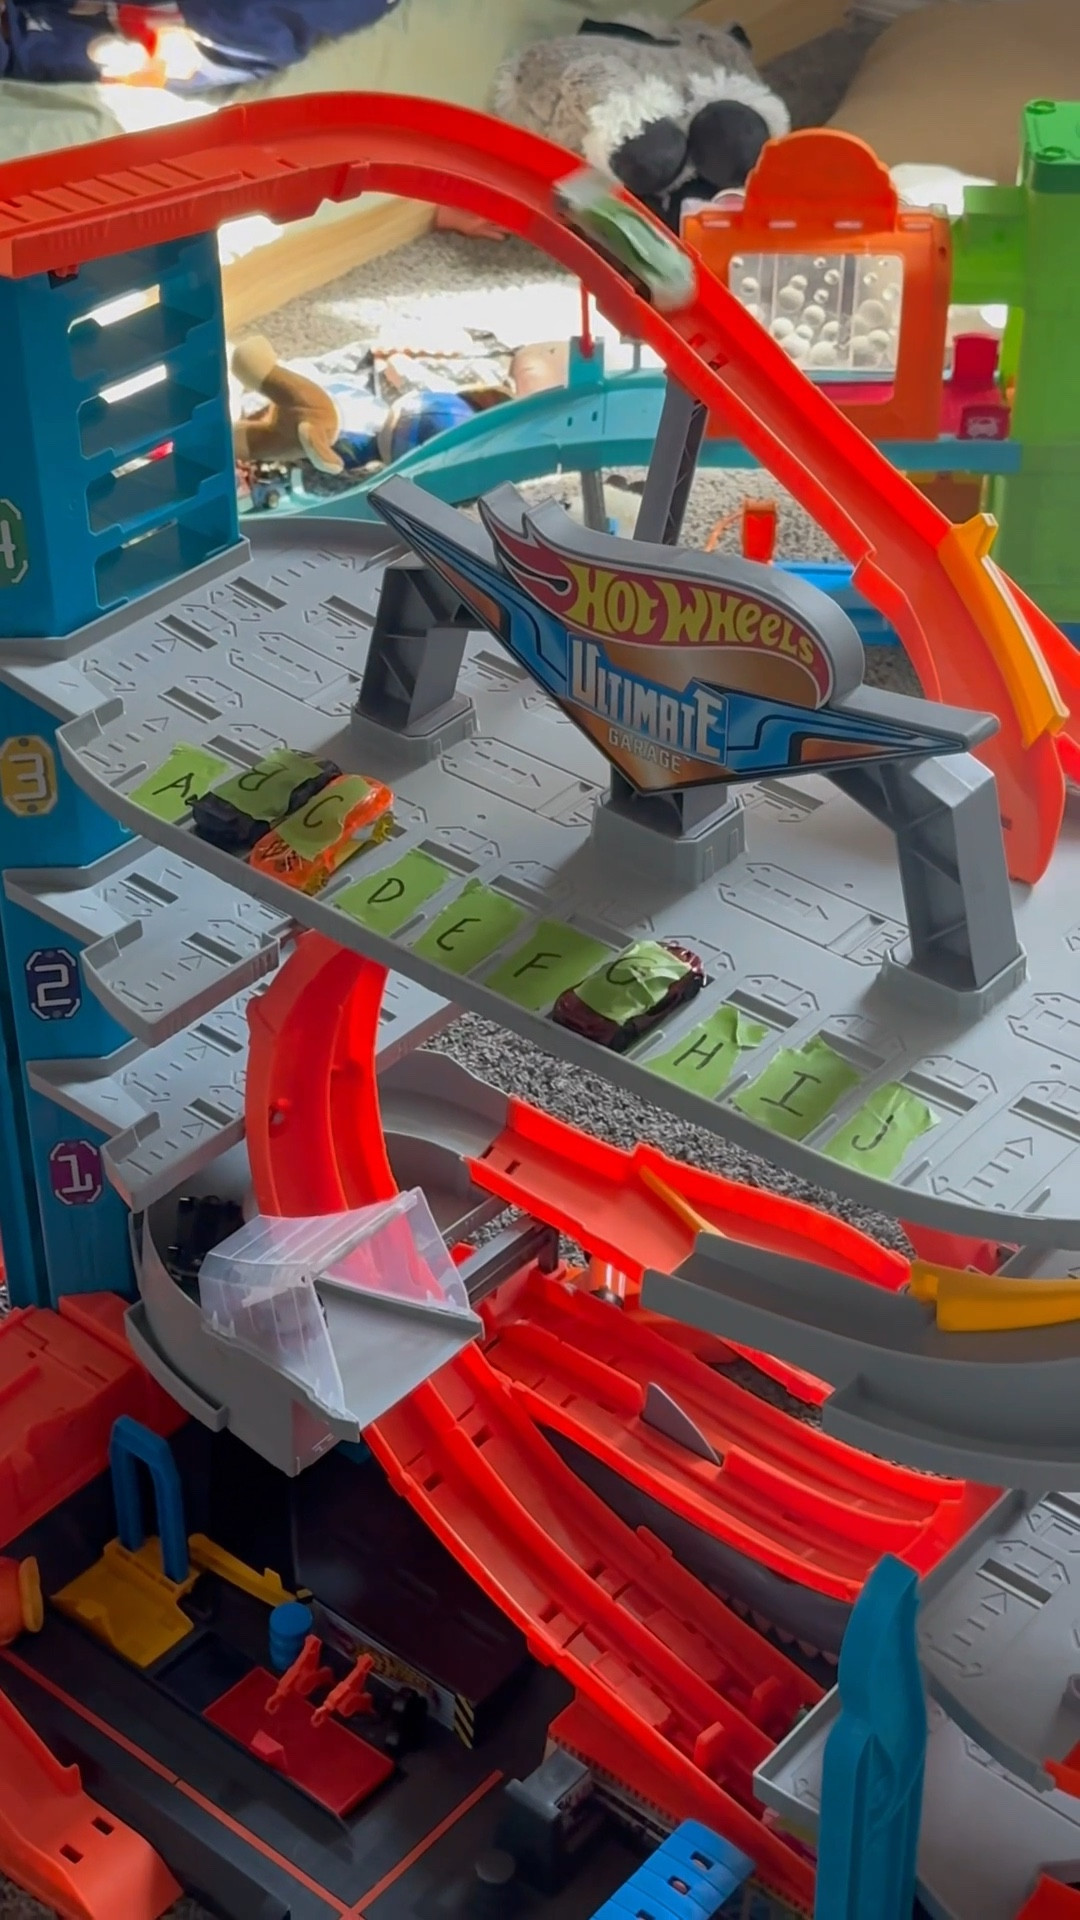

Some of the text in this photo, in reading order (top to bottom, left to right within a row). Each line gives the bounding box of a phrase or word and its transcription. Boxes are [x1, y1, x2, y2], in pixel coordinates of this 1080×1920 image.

[559, 559, 815, 665] Hot Wheels
[572, 639, 723, 760] ULTIMATE
[608, 727, 682, 776] GARAGE
[8, 752, 47, 800] 3
[151, 772, 195, 798] A
[302, 795, 345, 828] C
[367, 877, 405, 904] D
[436, 918, 482, 951] E
[512, 952, 562, 978] F
[34, 963, 71, 1008] 2
[672, 1033, 725, 1071] H
[759, 1070, 822, 1117] I
[851, 1114, 895, 1151] J
[57, 1153, 94, 1194] 1
